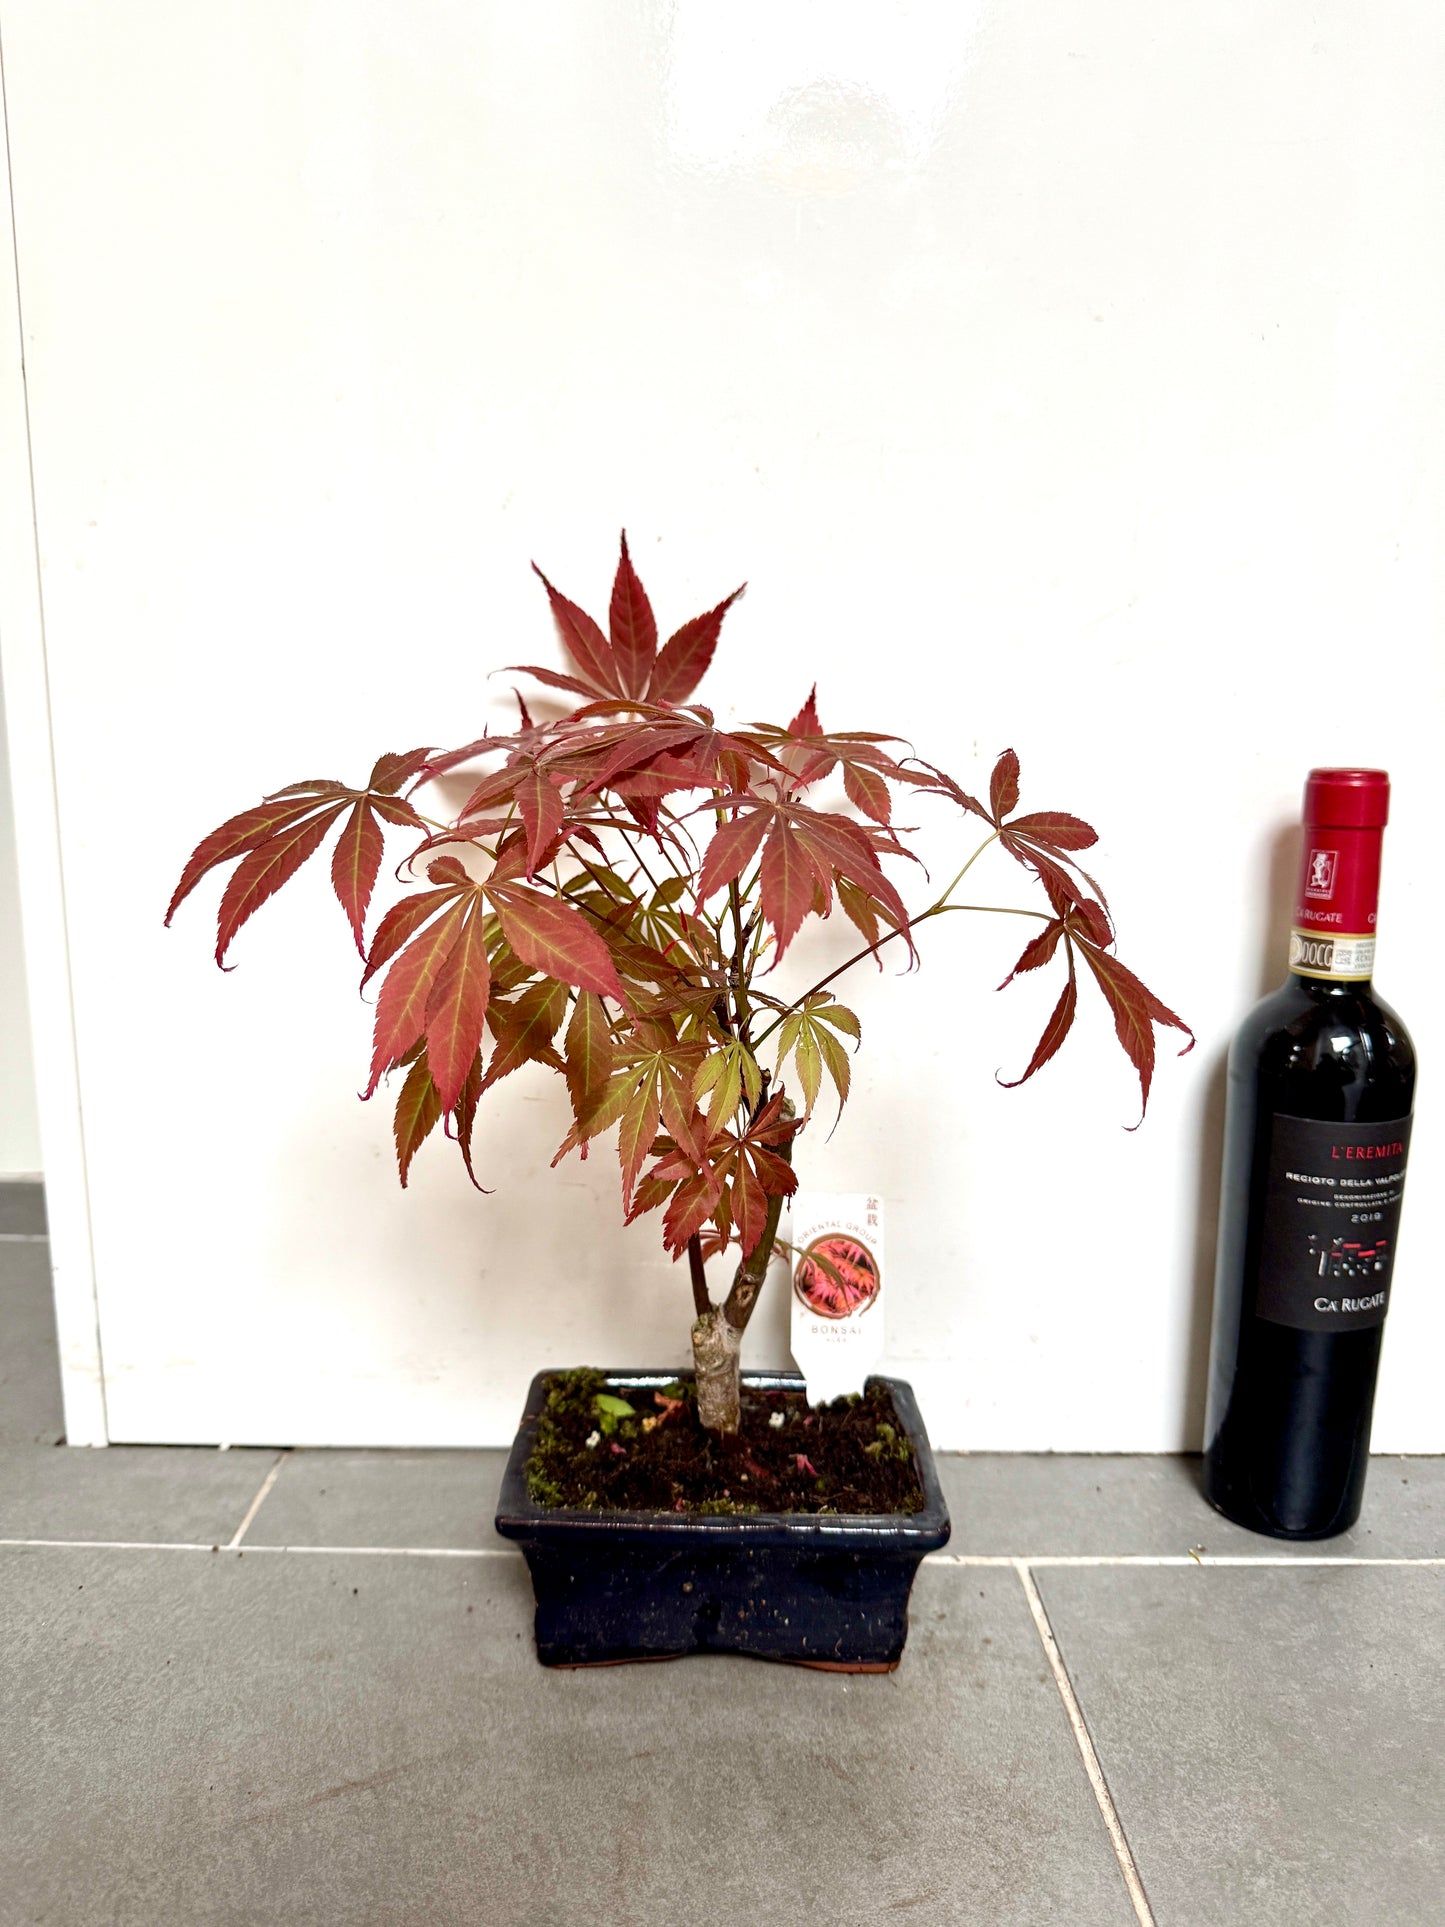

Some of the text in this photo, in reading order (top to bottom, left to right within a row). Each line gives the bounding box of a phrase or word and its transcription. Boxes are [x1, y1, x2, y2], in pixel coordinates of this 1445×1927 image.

[1304, 909, 1343, 924] RUGATE
[1301, 941, 1334, 967] DOCG
[1331, 1142, 1402, 1160] L'EREMITA
[1339, 1178, 1373, 1188] DELLA
[1297, 1197, 1332, 1208] ORIGINE
[797, 1220, 877, 1245] ORIENTAL GROUP
[1341, 1291, 1385, 1312] RUGATE
[811, 1325, 862, 1335] BONSAI
